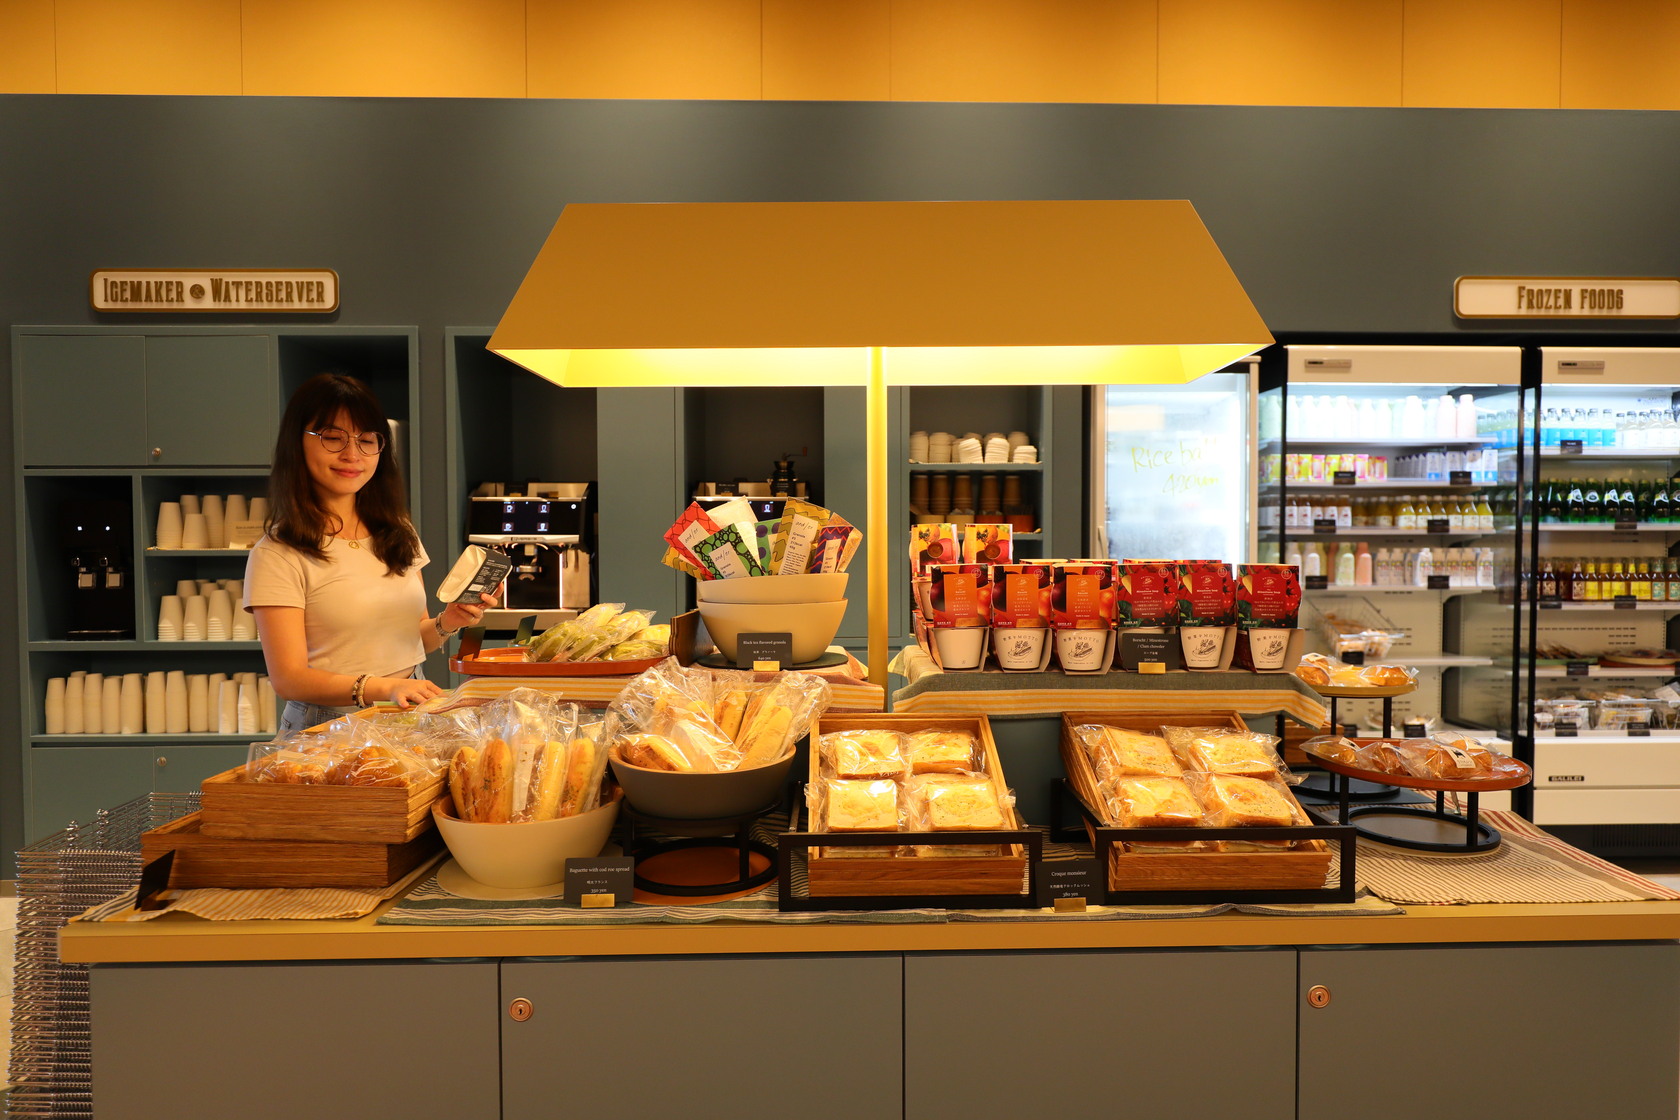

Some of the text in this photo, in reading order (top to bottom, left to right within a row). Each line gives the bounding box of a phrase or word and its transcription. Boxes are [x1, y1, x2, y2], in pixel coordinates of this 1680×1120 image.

[190, 284, 205, 299] &
[210, 277, 325, 303] WATERSERVER
[1517, 285, 1624, 310] FROZEN FOODS
[1131, 447, 1175, 473] Rice
